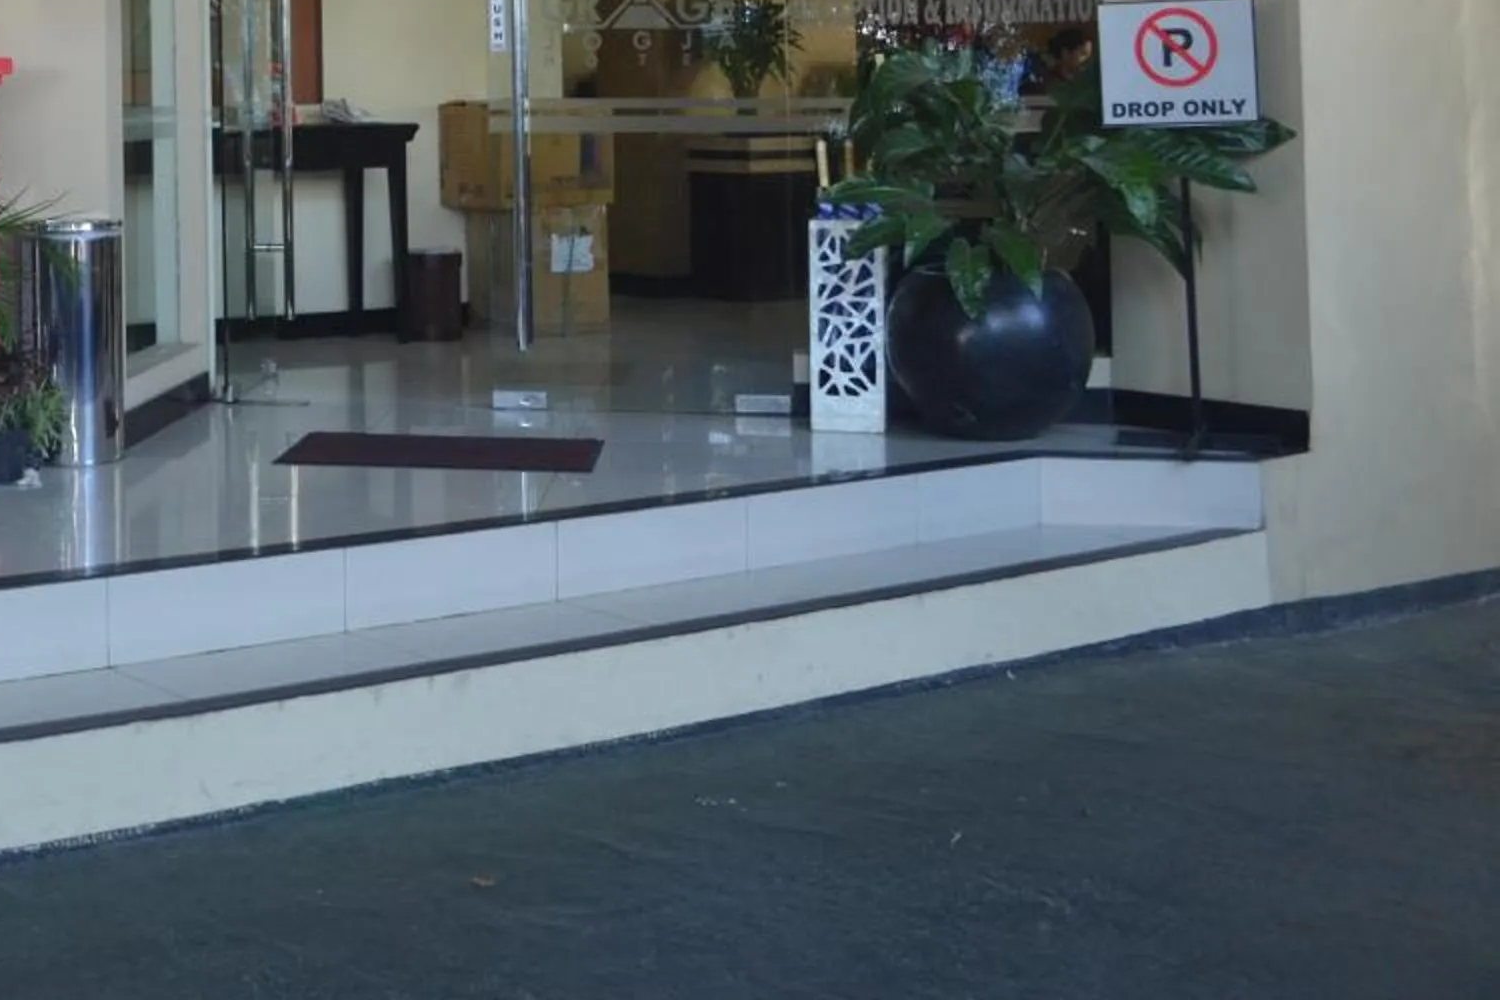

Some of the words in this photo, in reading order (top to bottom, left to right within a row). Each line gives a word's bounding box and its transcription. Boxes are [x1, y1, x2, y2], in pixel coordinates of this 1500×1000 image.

[1163, 28, 1193, 67] P
[1111, 101, 1175, 119] DROP
[1183, 99, 1247, 116] ONLY
